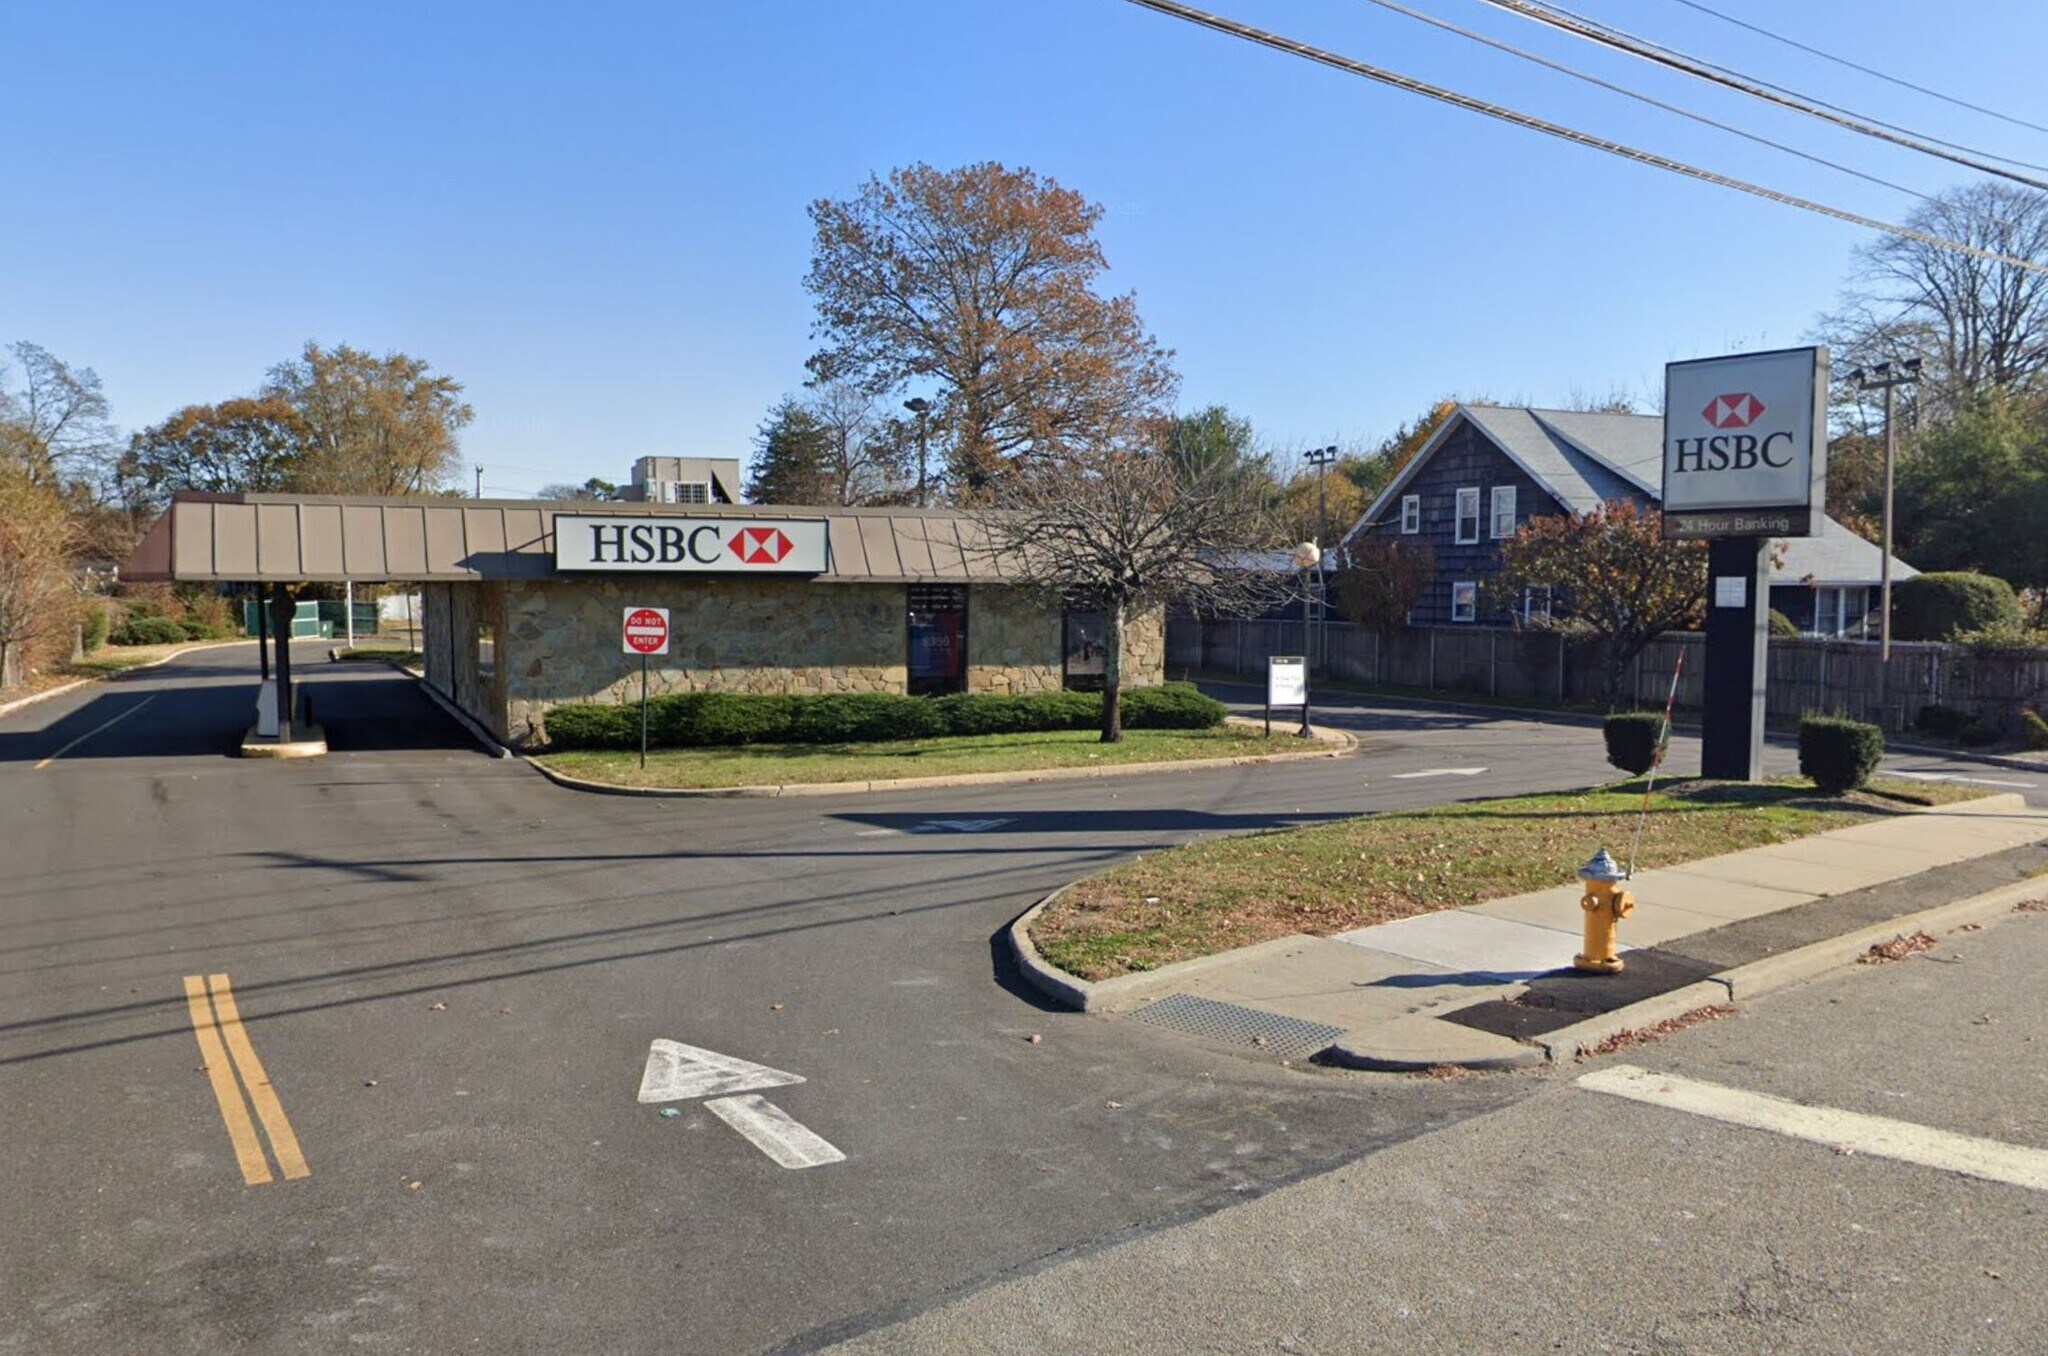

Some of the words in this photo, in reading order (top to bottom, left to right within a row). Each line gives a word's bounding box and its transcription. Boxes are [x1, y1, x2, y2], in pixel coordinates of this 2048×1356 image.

[1673, 431, 1793, 473] HSBC
[1698, 519, 1732, 532] Hour
[1735, 517, 1789, 532] Banking
[589, 524, 722, 564] HSBC
[630, 617, 642, 625] DO
[645, 617, 662, 626] NOT
[633, 637, 658, 645] ENTER
